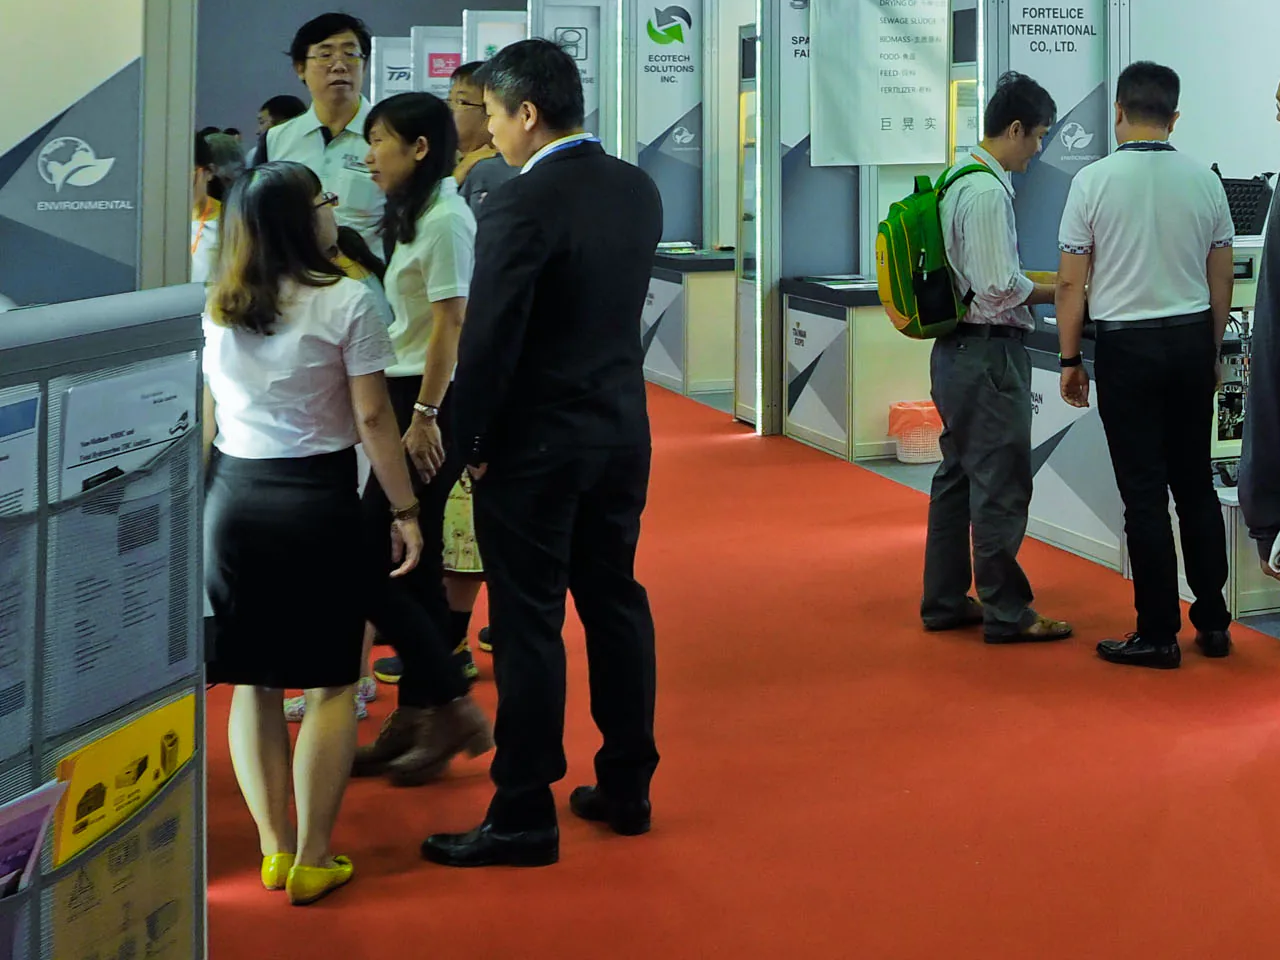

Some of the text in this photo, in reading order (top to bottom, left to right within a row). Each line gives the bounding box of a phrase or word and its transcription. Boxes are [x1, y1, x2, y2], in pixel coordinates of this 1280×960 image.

[1022, 8, 1084, 19] FORTELICE
[879, 17, 908, 25] SEWAGE
[1010, 24, 1096, 36] INTERNATIONAL
[1030, 41, 1077, 54] CO., LTD.
[794, 49, 809, 58] FA
[644, 65, 694, 73] SOLUTIONS
[37, 200, 134, 211] ENVIRONMENTAL
